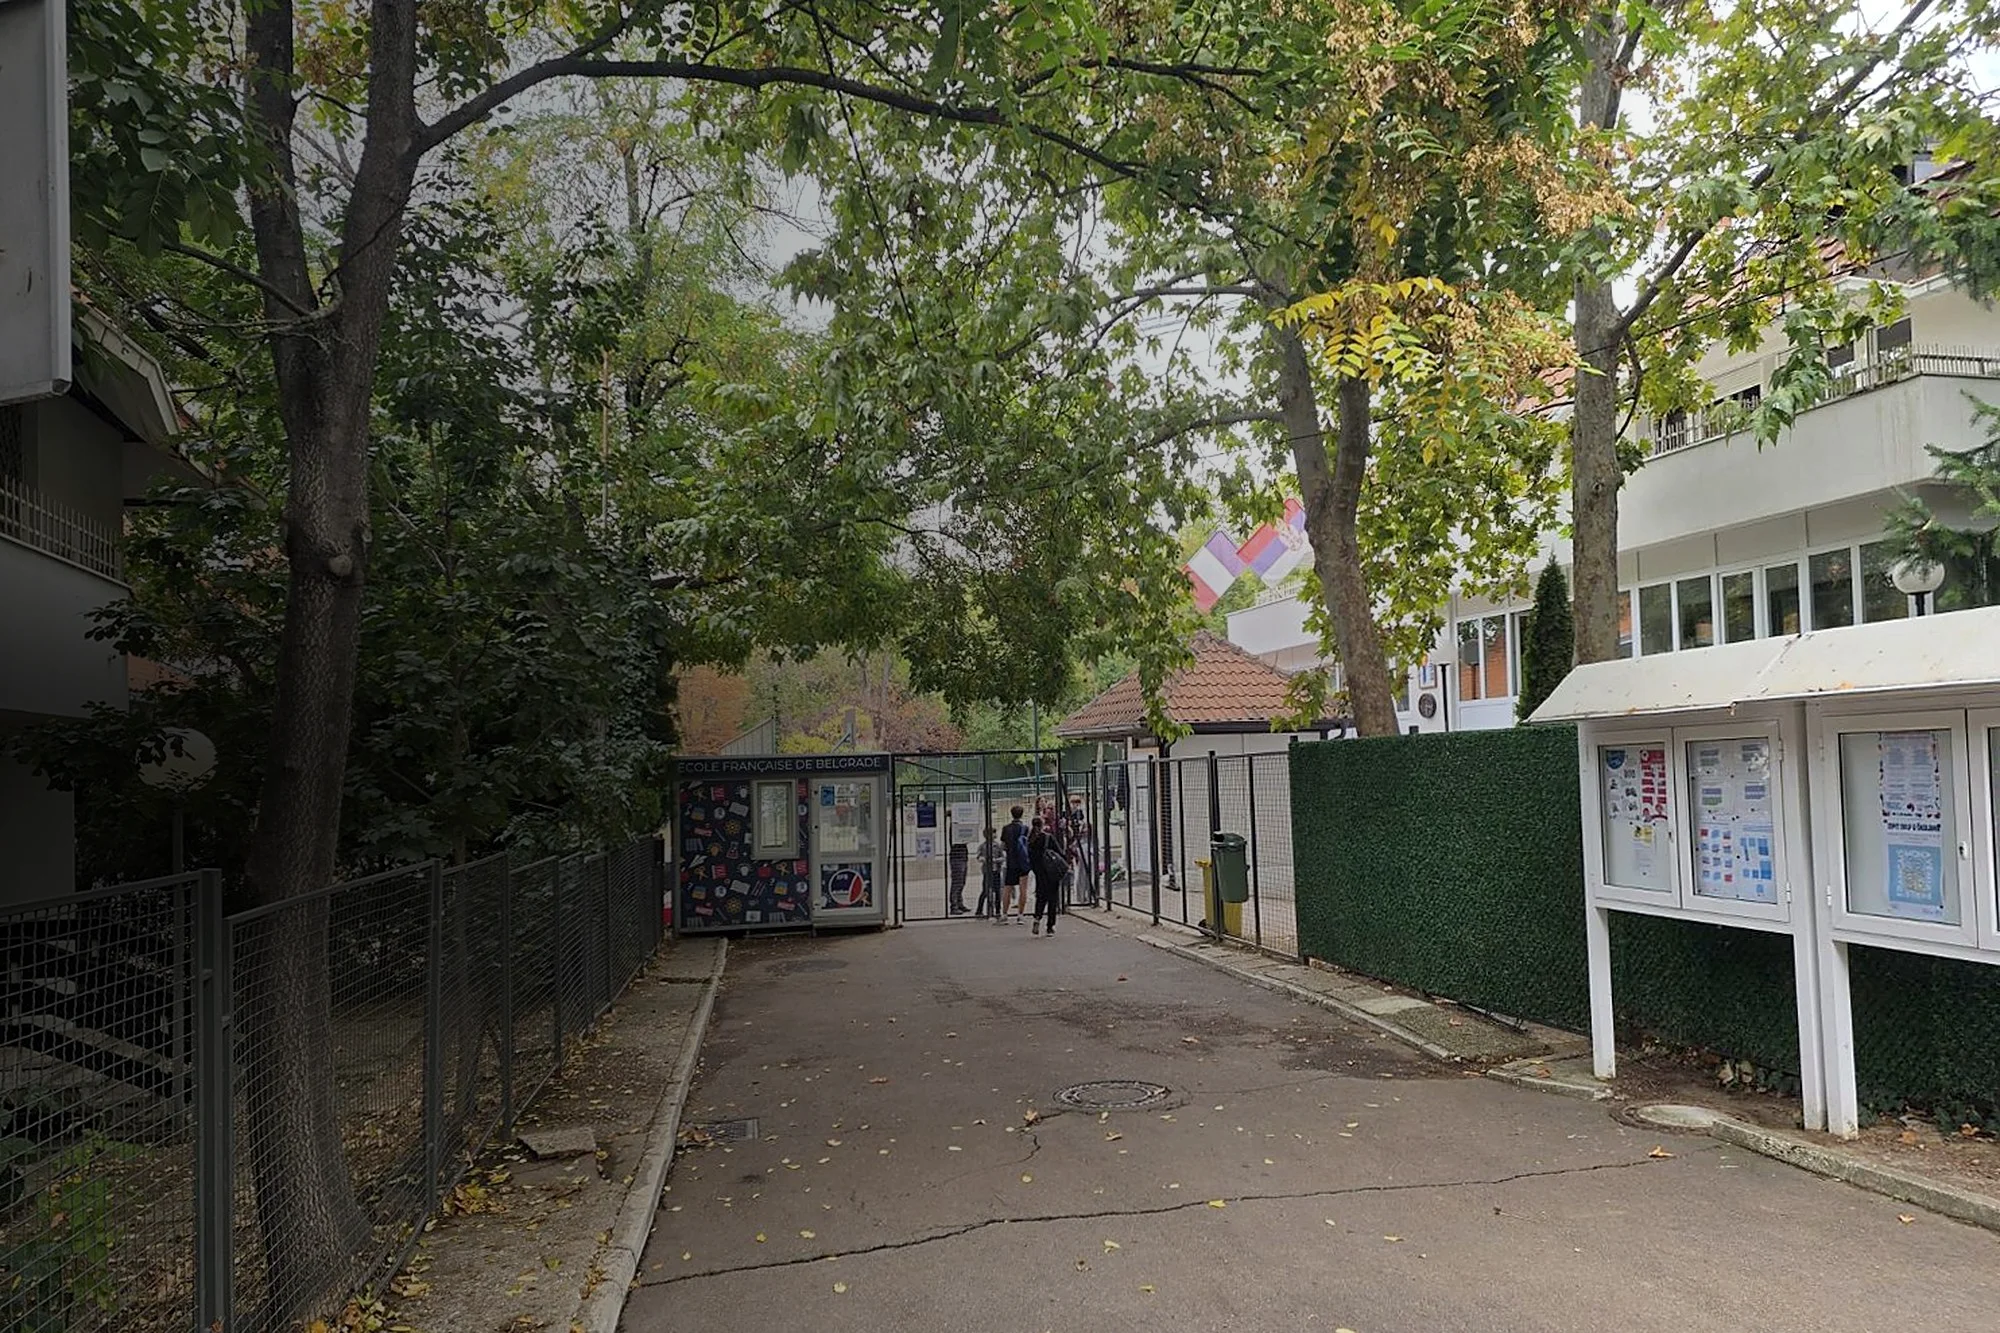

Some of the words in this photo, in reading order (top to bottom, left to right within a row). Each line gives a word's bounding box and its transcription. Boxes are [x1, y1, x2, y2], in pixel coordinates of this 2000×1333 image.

[722, 760, 793, 773] FRANÇAISE
[795, 759, 812, 771] DE
[816, 757, 881, 769] BELGRADE
